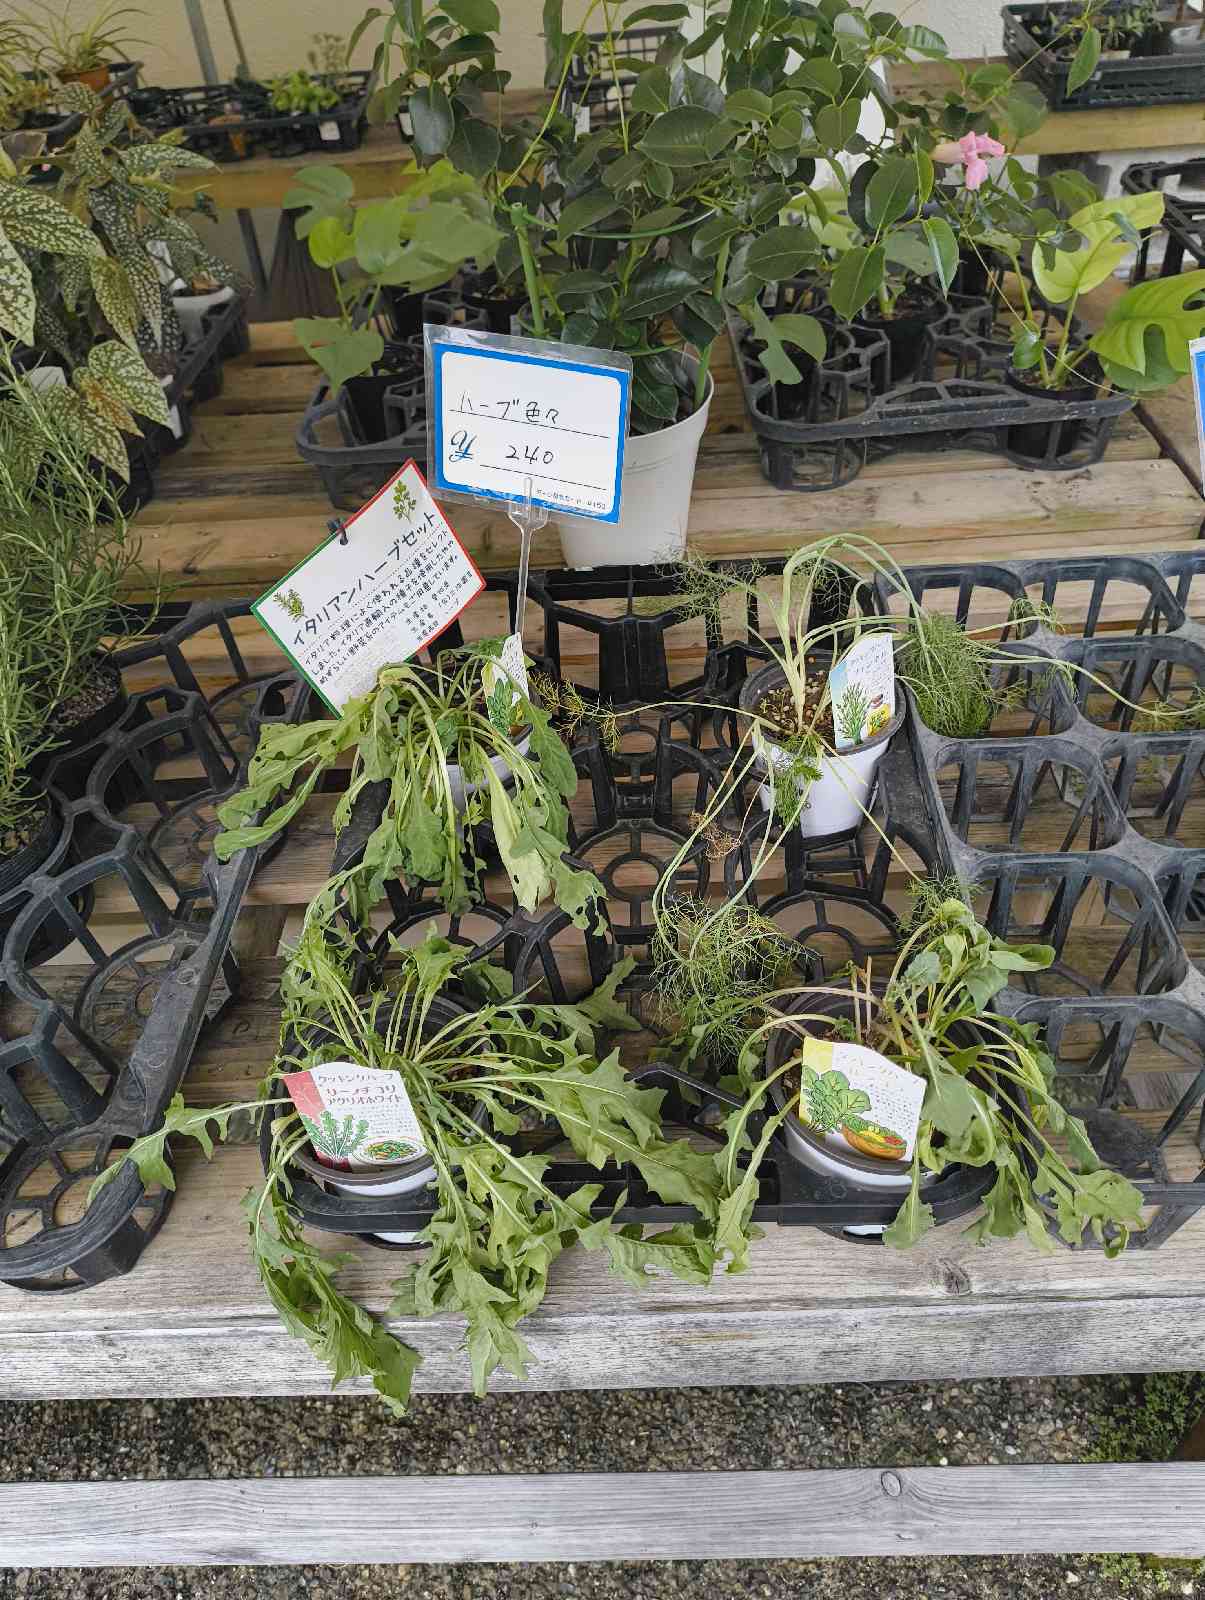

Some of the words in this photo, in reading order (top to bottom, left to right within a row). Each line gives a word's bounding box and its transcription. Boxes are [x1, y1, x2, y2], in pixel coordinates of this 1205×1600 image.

[505, 445, 555, 465] 240
[293, 511, 435, 646] イタリアンハーブセット
